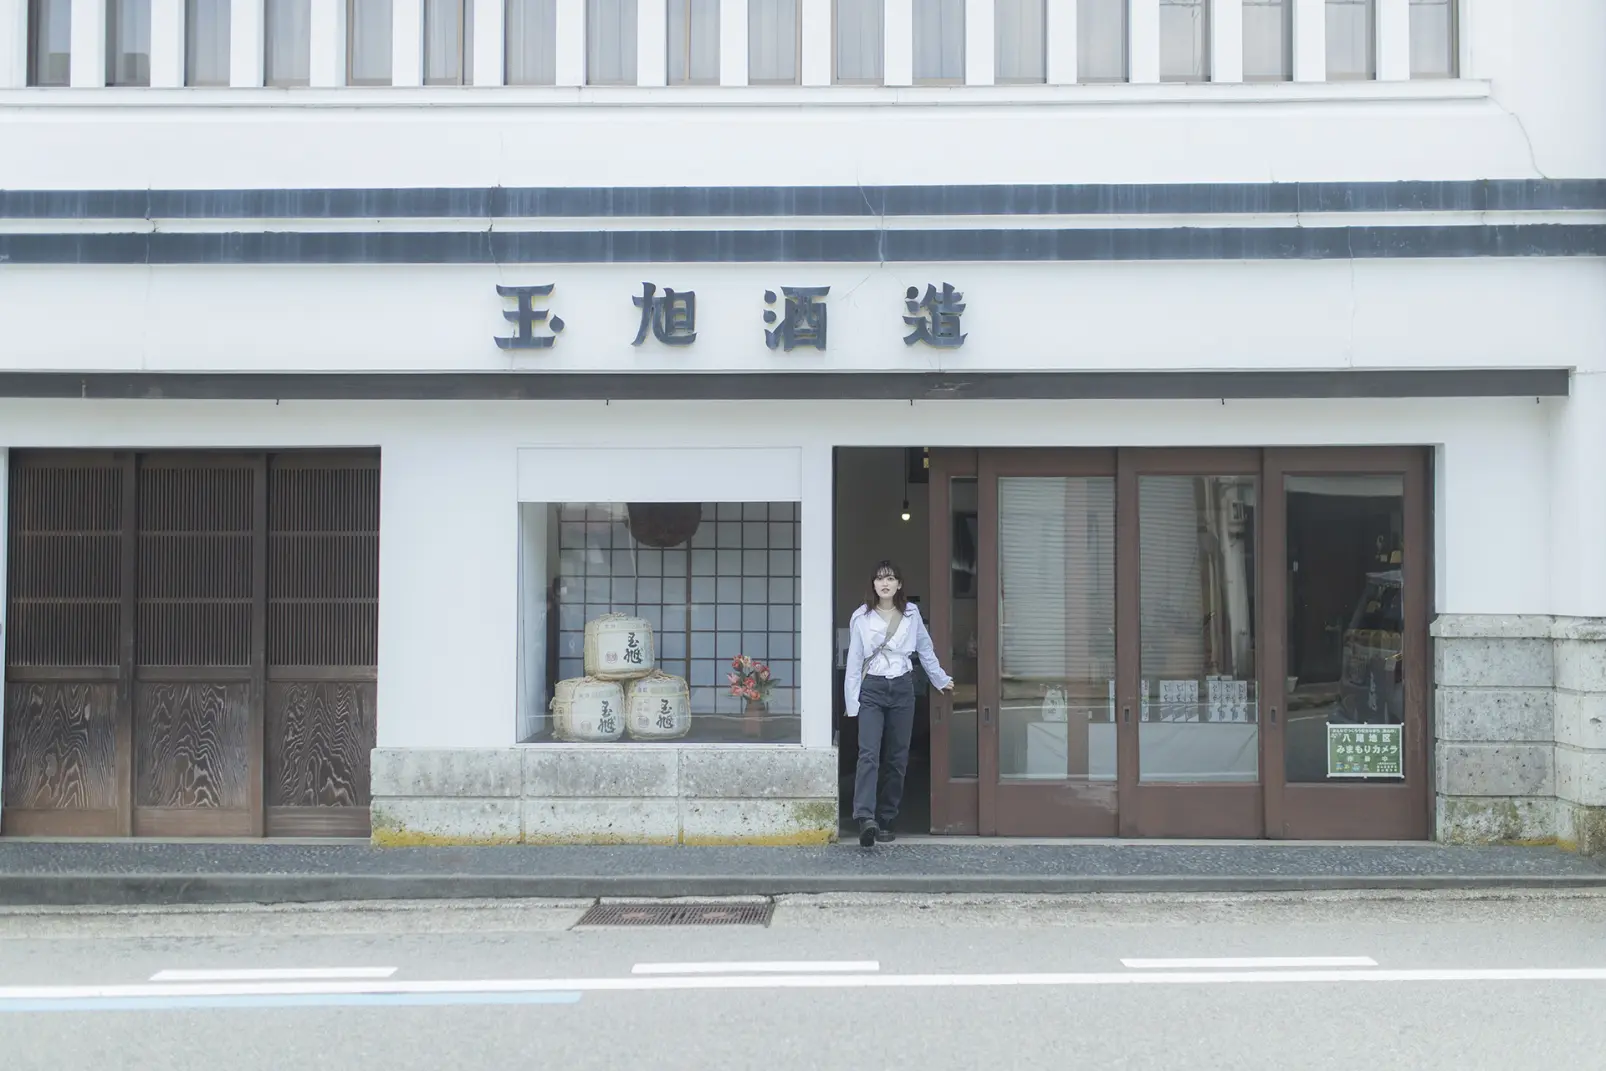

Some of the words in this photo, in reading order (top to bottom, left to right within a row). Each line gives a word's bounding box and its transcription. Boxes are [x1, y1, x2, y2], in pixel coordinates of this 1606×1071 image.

[494, 281, 968, 352] 玉旭酒造
[1337, 745, 1398, 754] みまもりカメラ
